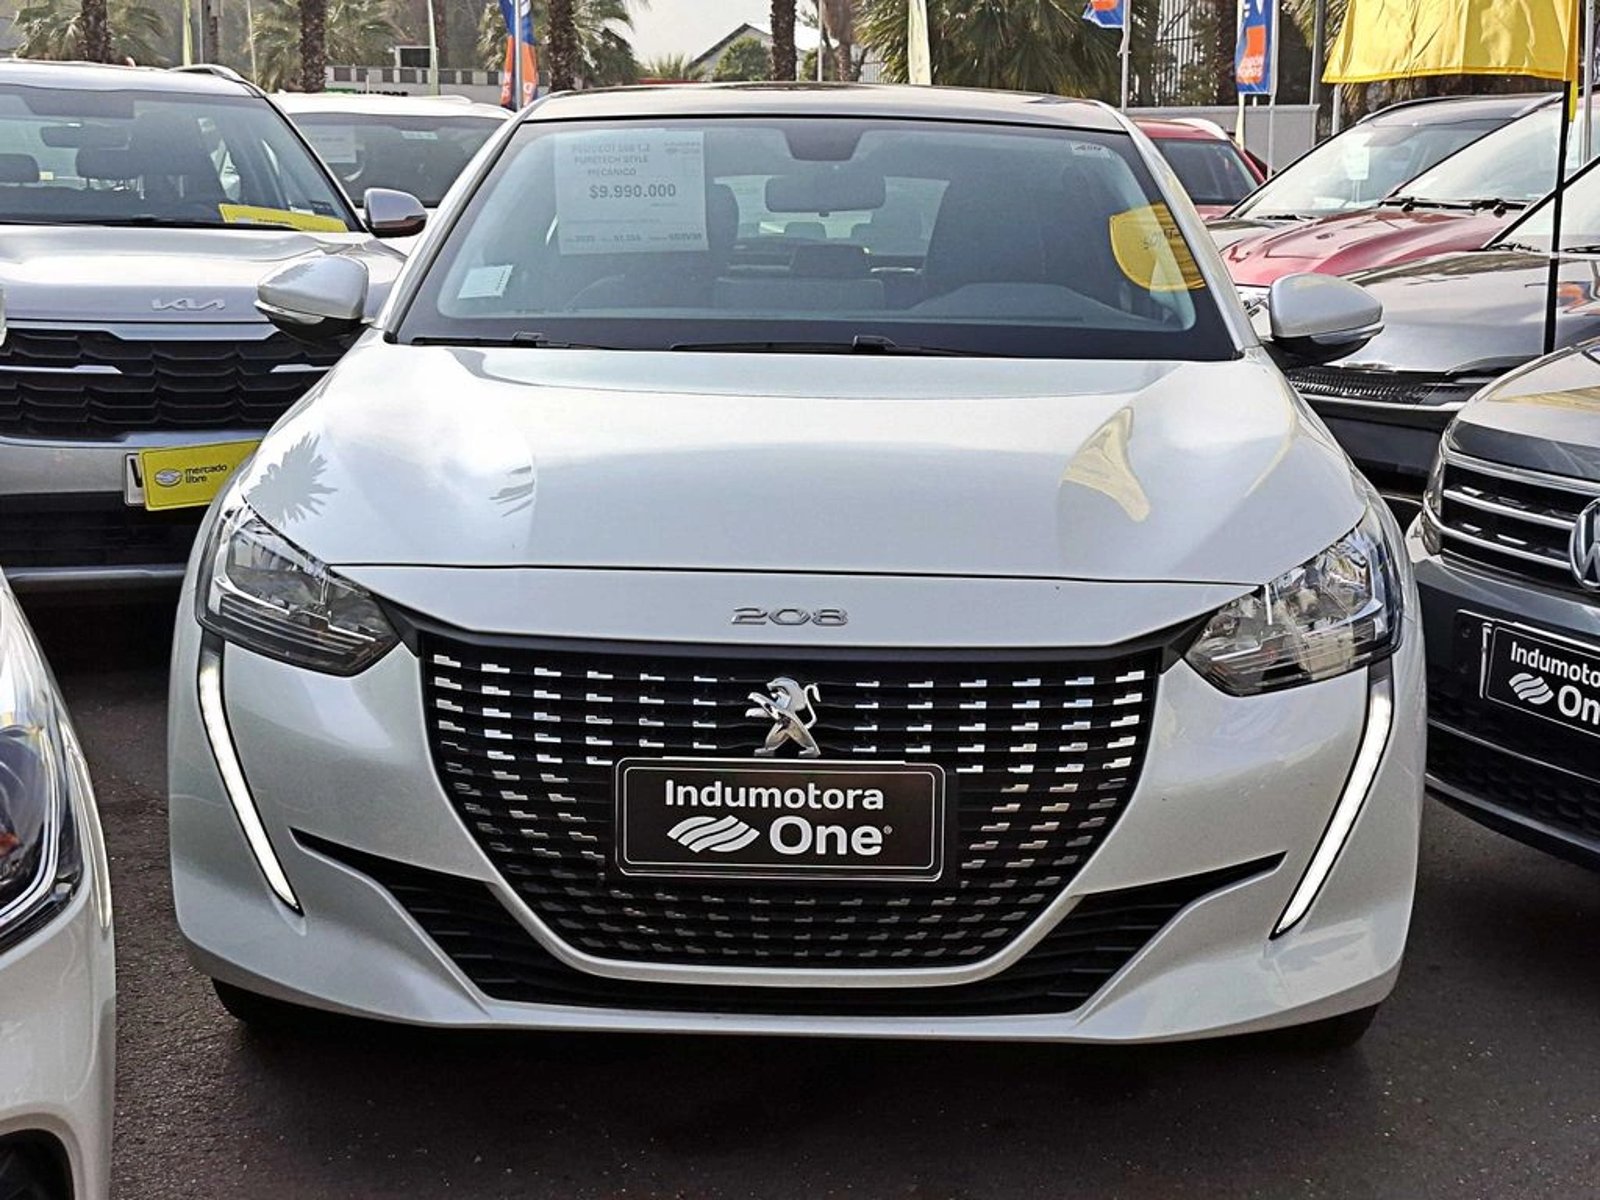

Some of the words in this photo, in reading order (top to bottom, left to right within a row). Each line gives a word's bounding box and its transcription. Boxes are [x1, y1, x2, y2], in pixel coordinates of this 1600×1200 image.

[589, 183, 677, 199] $9.990.000
[185, 464, 228, 475] mercado
[731, 607, 849, 626] 208
[664, 778, 884, 810] Indumotora
